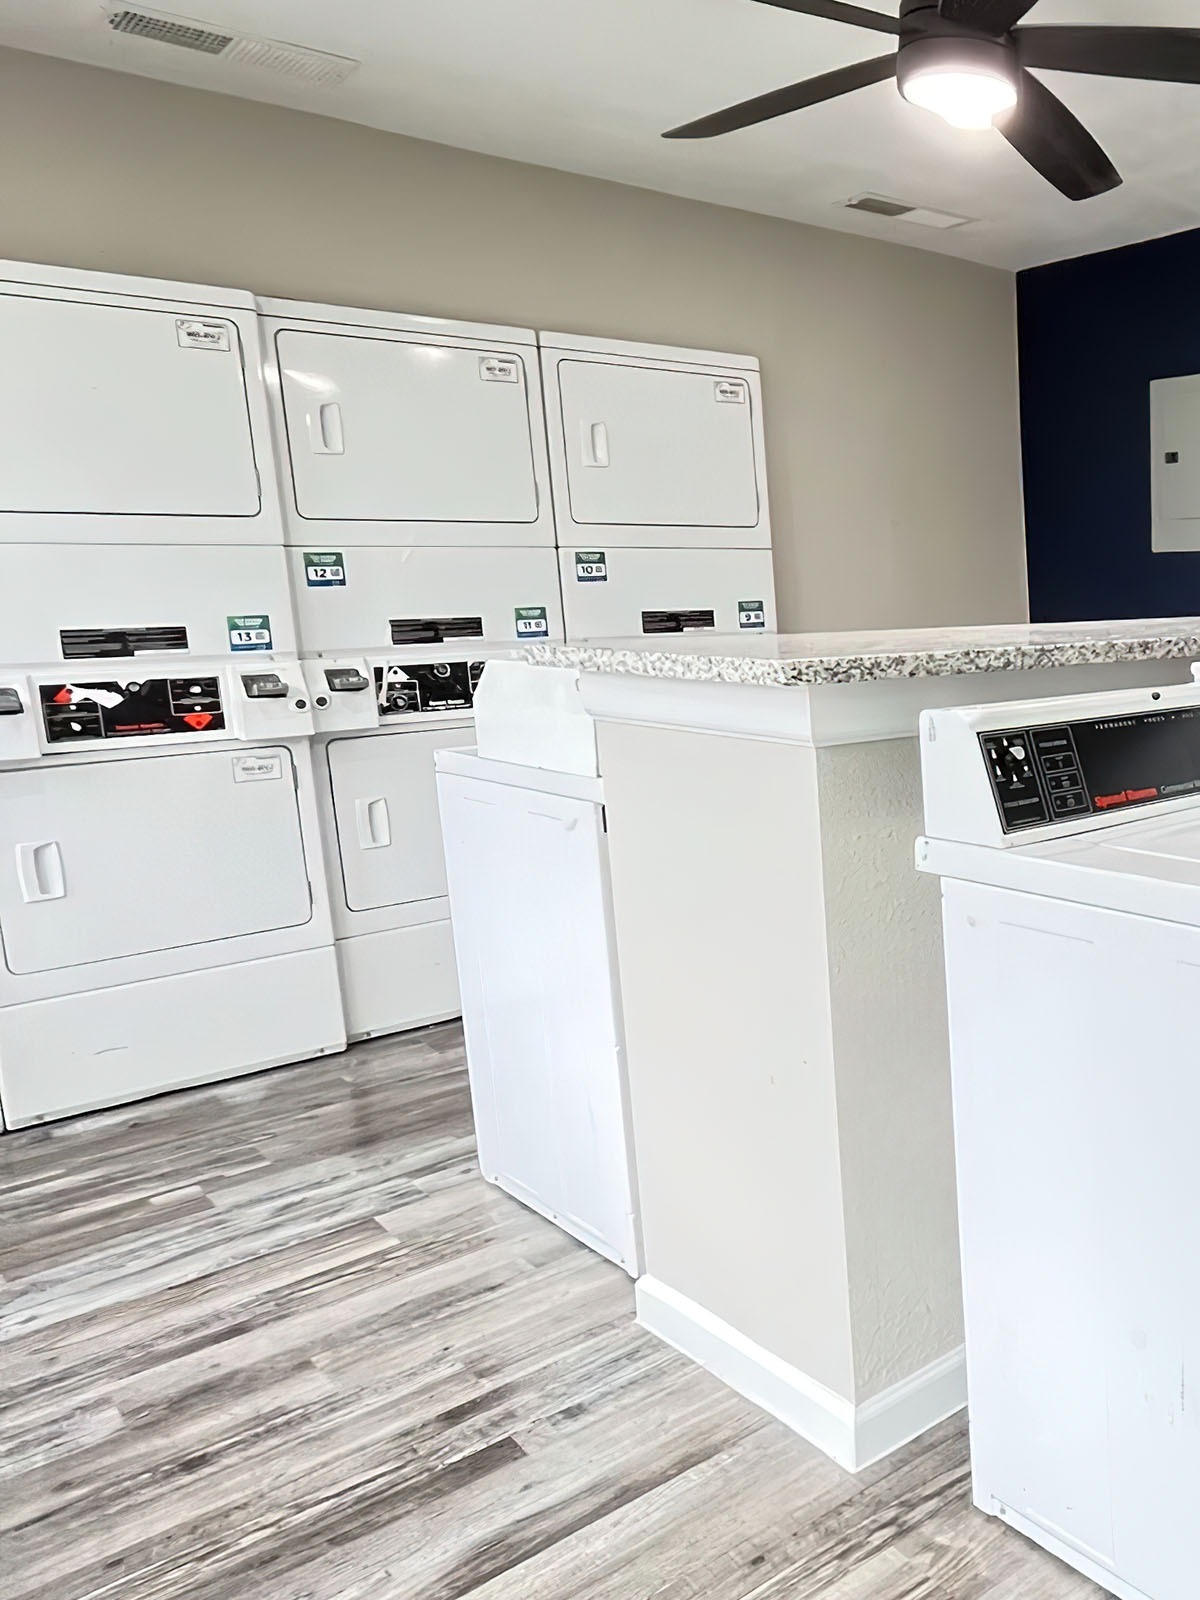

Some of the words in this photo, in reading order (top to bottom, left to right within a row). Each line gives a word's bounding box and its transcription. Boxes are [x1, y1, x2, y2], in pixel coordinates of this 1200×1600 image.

[313, 568, 327, 578] 12
[580, 565, 594, 575] 10
[237, 632, 252, 642] 13
